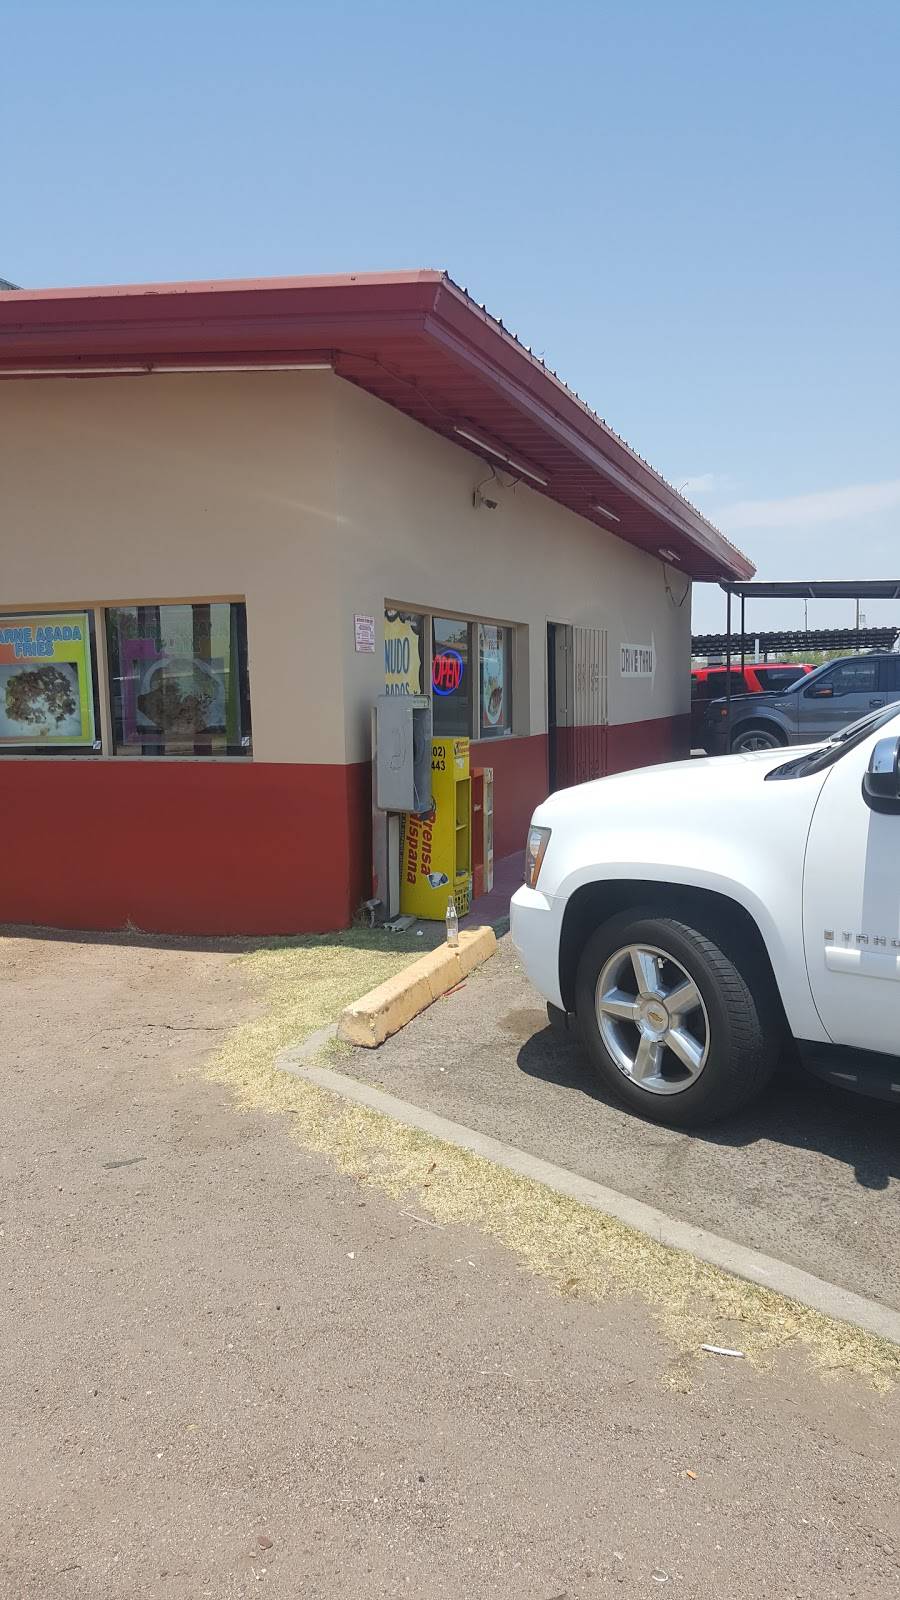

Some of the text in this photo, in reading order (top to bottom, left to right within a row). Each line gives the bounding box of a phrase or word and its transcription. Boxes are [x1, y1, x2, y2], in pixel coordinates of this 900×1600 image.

[36, 626, 81, 641] ASADA
[15, 642, 54, 657] FRIES
[385, 637, 410, 674] NUDO
[432, 654, 461, 689] OPEN
